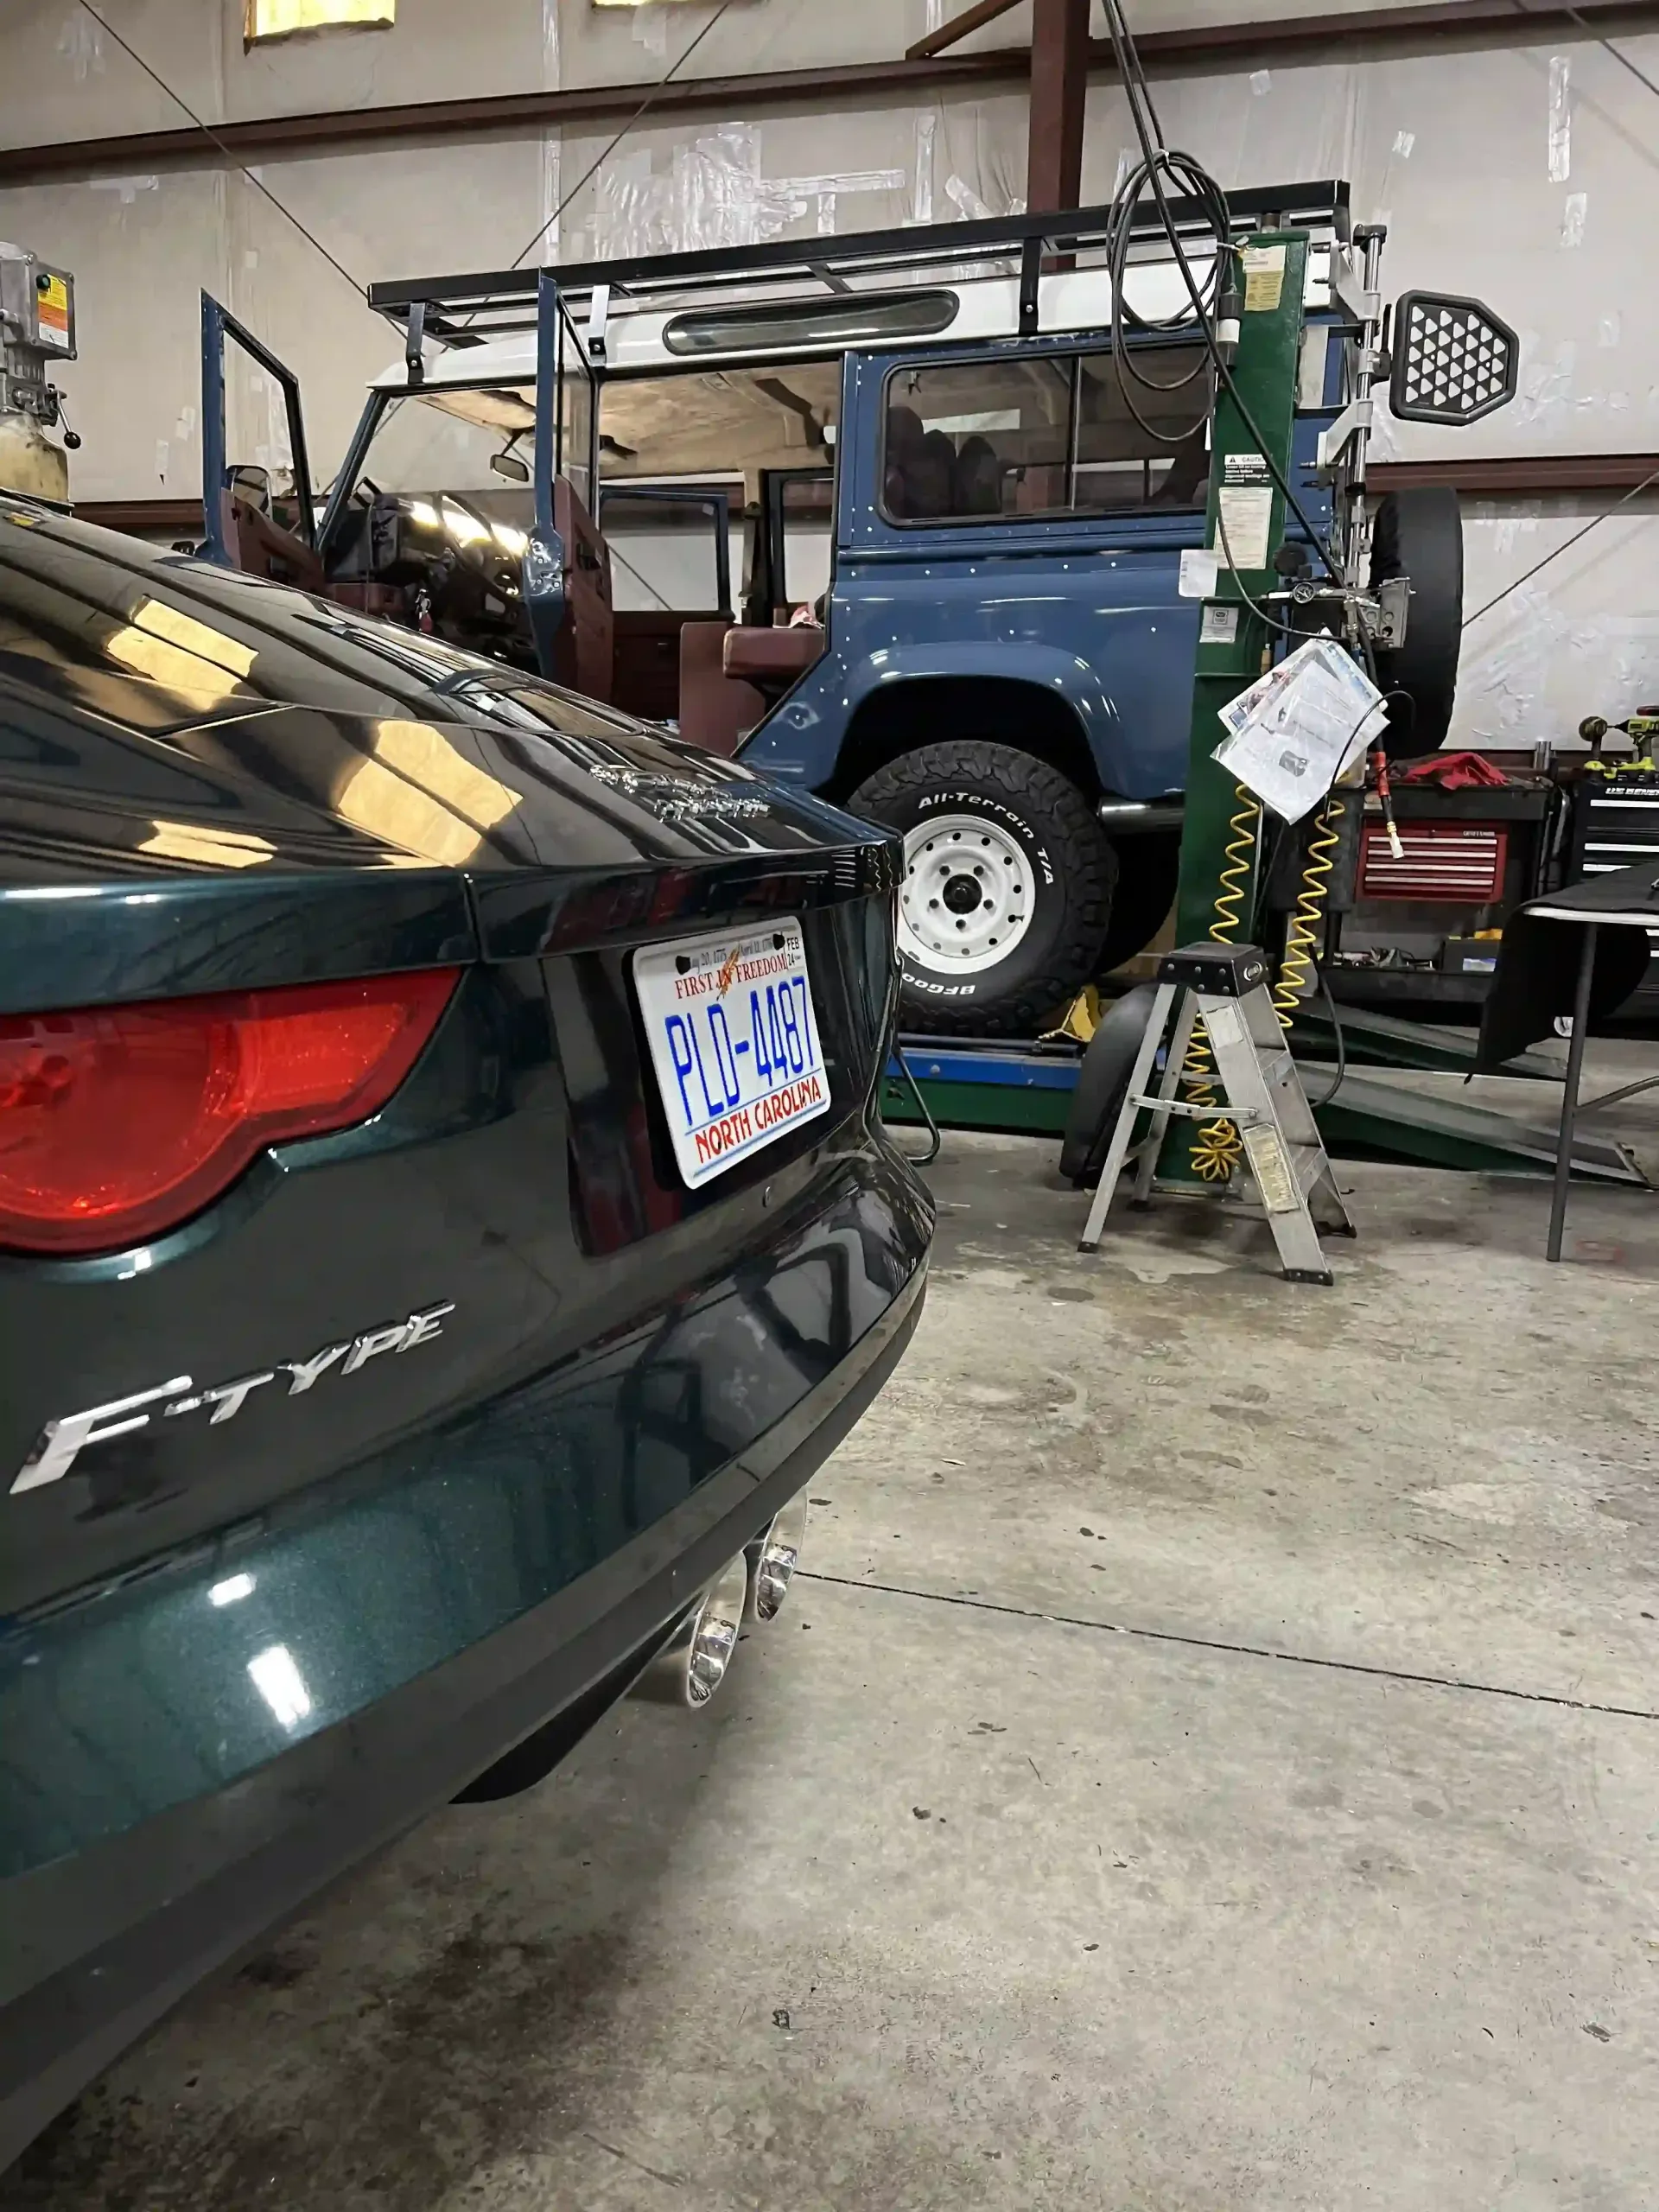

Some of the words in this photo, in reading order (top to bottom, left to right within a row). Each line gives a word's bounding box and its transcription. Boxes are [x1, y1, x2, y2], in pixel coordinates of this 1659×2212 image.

[918, 791, 1034, 839] All-Terrain
[1037, 847, 1054, 884] T/A
[786, 937, 800, 950] FEB
[786, 954, 795, 967] 24
[675, 971, 715, 999] FIRST
[716, 967, 733, 988] IN
[734, 952, 788, 982] FREEDOM
[901, 973, 976, 995] BFGoo
[664, 975, 814, 1126] PLD-4487
[695, 1109, 753, 1164] NORTH
[754, 1076, 822, 1132] CAROLINA
[9, 1298, 457, 1495] F-TYPE
